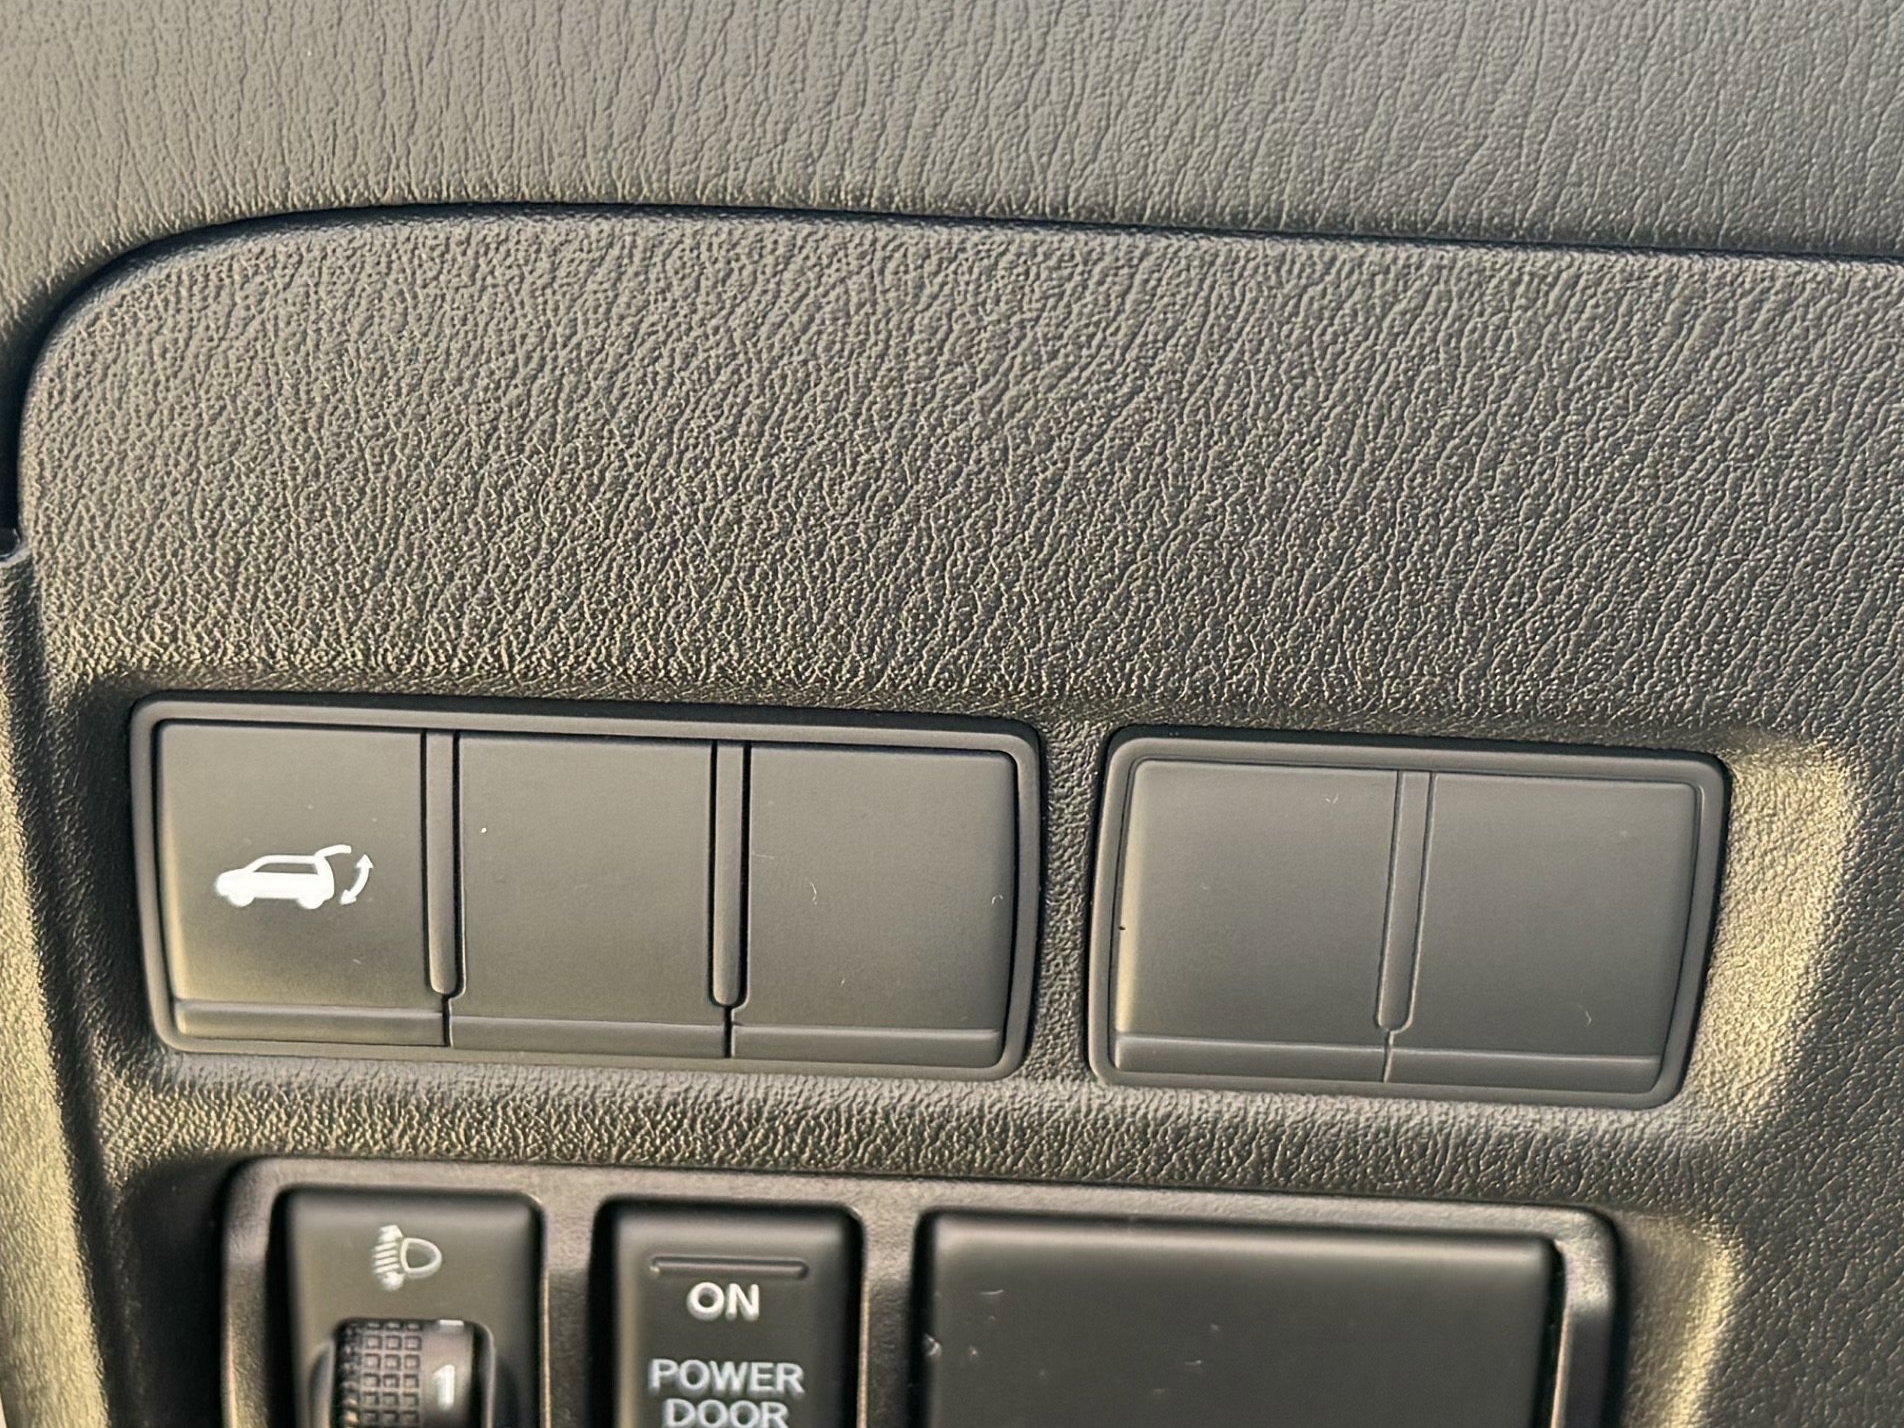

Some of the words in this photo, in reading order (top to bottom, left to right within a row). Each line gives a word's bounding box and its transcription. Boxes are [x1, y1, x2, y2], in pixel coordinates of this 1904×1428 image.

[686, 1281, 760, 1321] ON
[432, 1364, 456, 1410] 1
[648, 1358, 806, 1399] POWER
